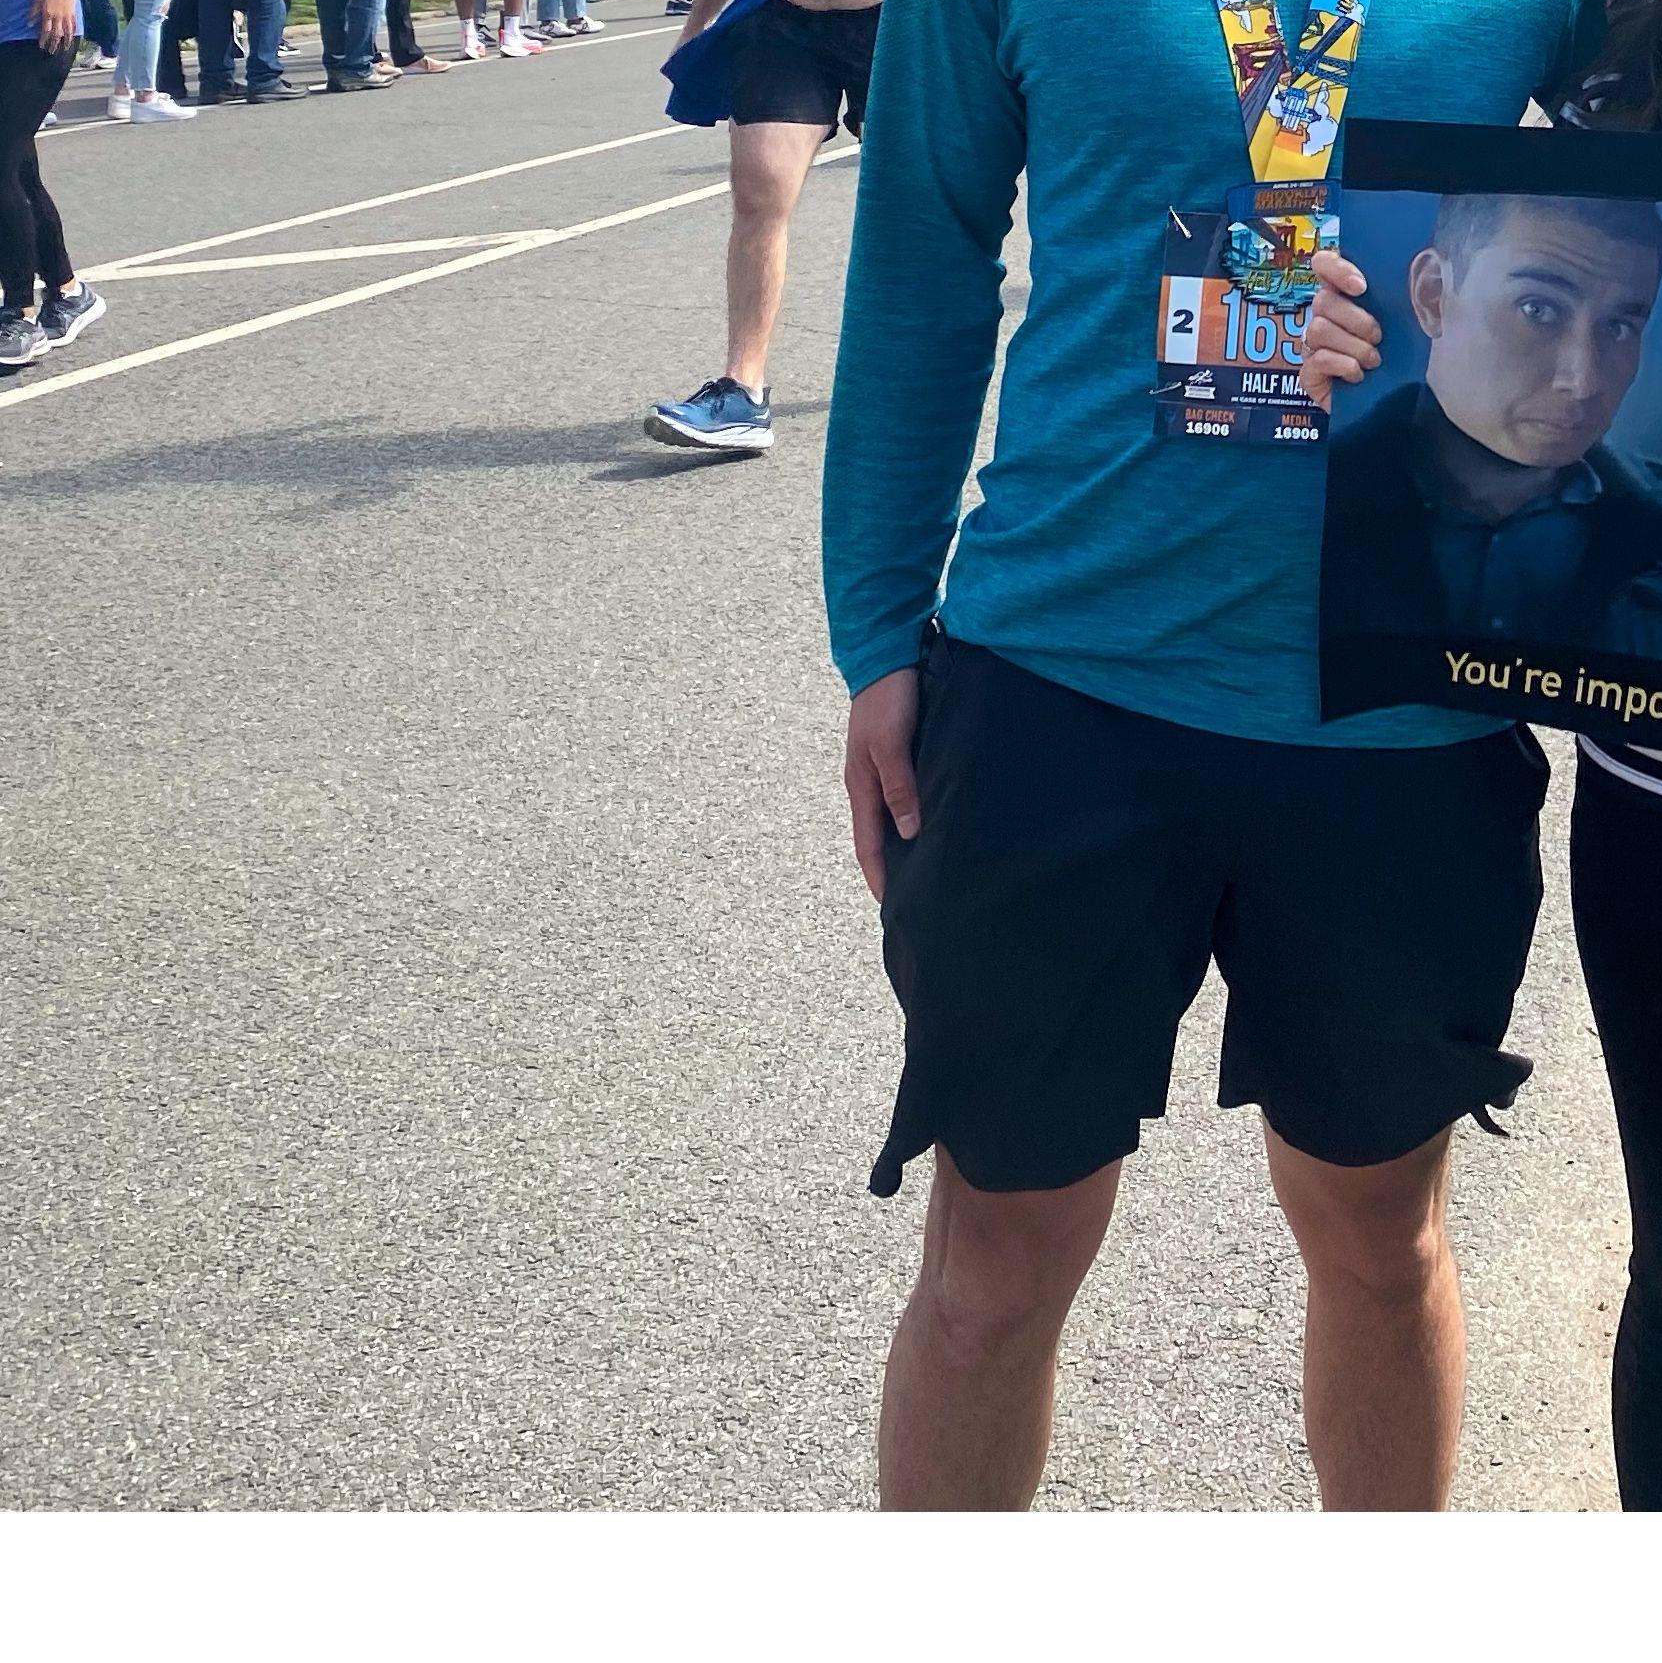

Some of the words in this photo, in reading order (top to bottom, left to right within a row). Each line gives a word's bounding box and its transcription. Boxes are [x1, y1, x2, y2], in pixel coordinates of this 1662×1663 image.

[1171, 309, 1195, 334] 2
[1242, 372, 1279, 394] HALF
[1281, 374, 1307, 395] MA
[1185, 408, 1204, 421] BAG
[1204, 409, 1236, 423] CHECK
[1281, 414, 1313, 427] MEDAL
[1186, 421, 1230, 437] 16906
[1273, 426, 1319, 440] 16906
[1445, 650, 1563, 698] You're
